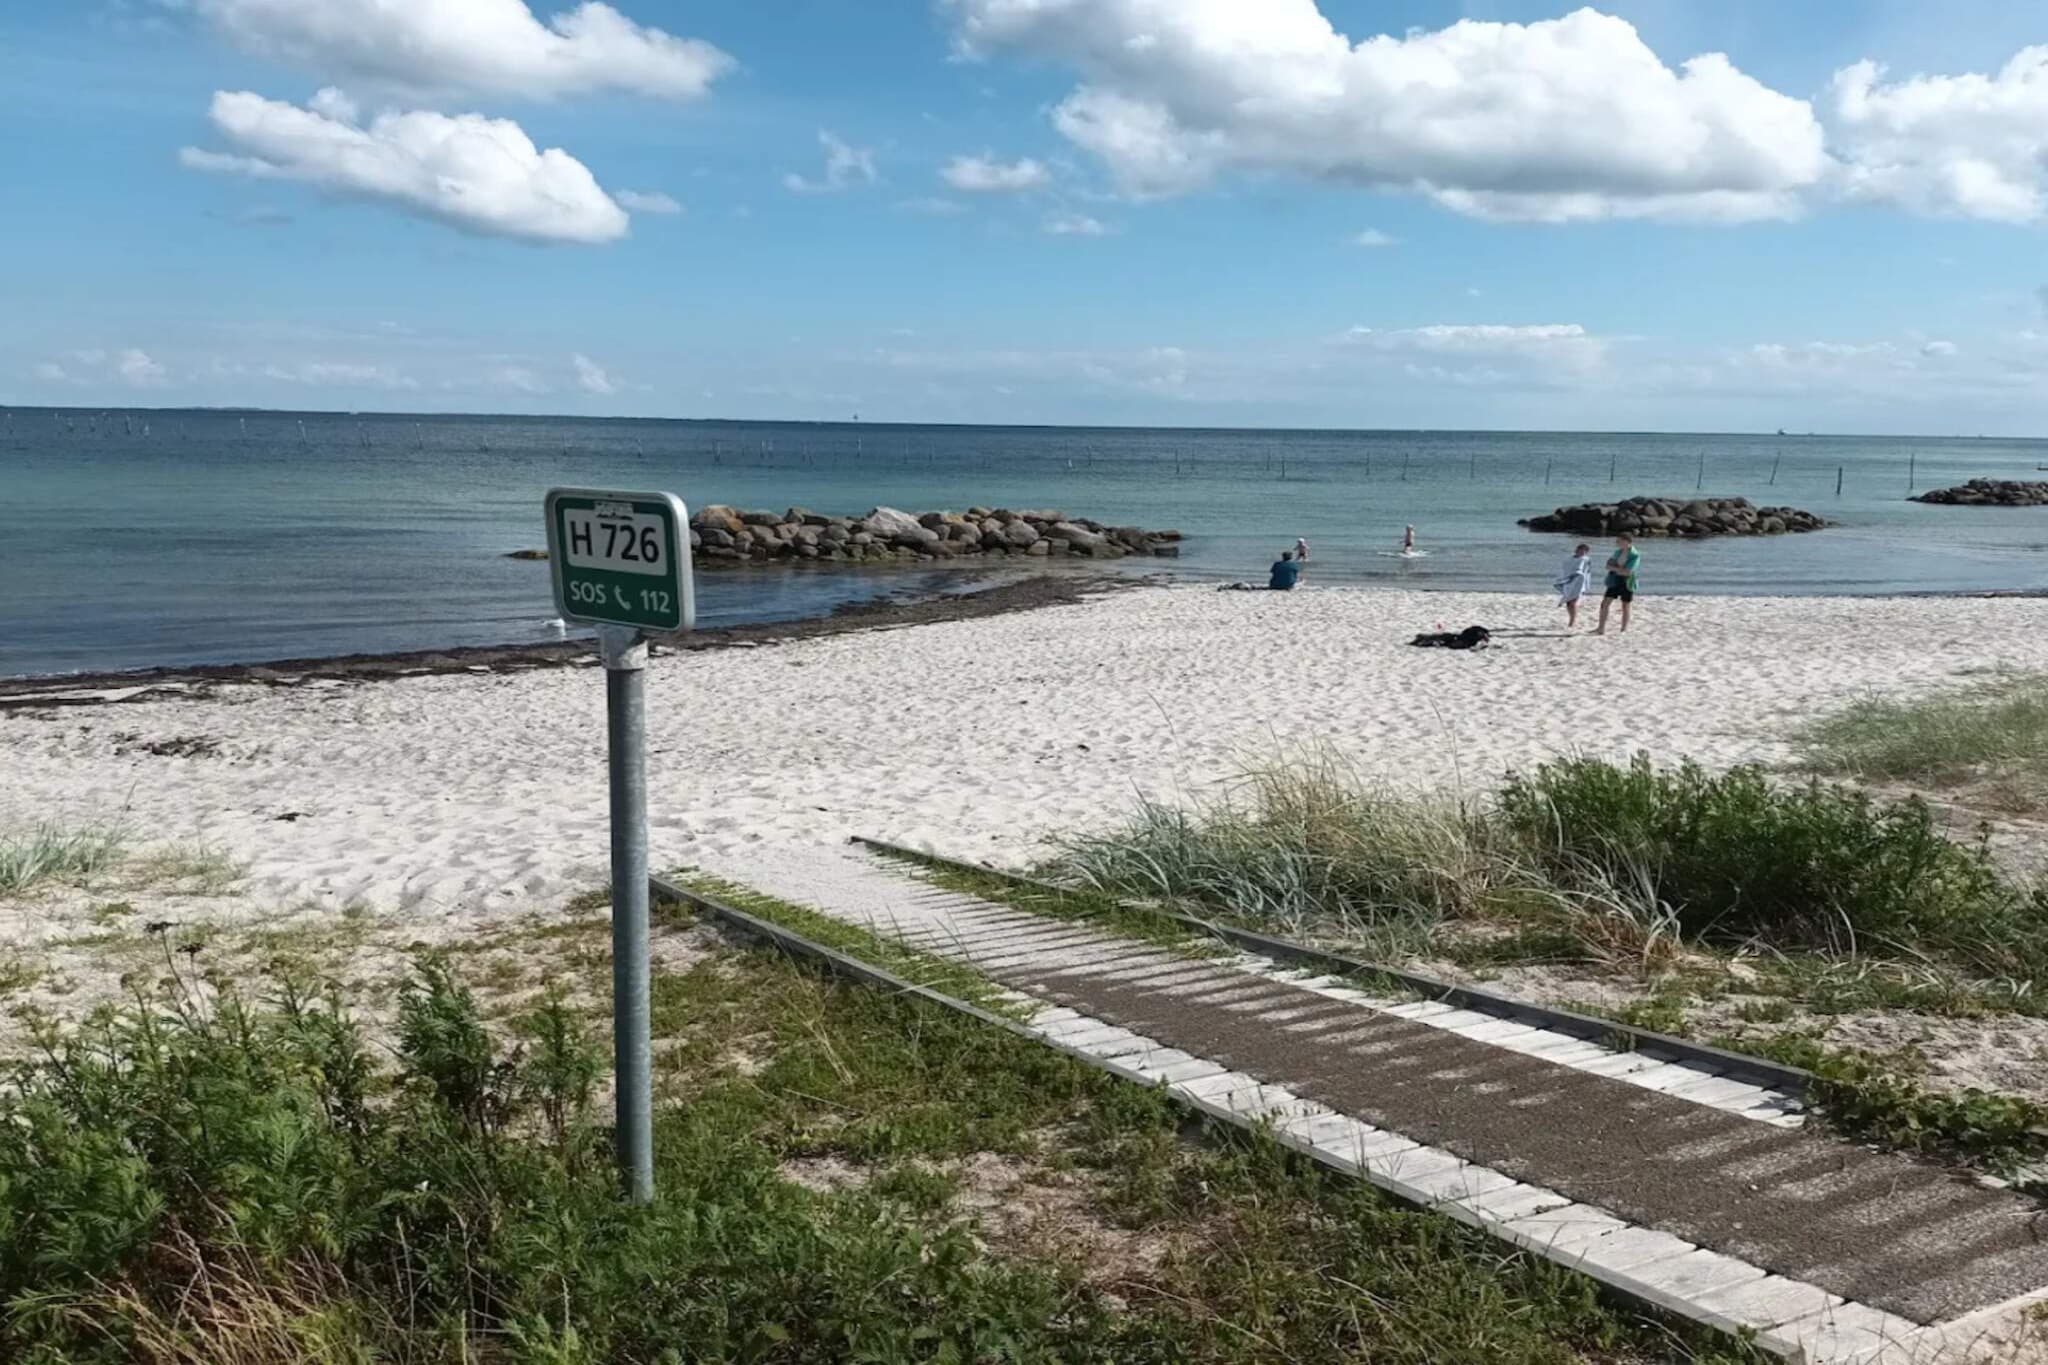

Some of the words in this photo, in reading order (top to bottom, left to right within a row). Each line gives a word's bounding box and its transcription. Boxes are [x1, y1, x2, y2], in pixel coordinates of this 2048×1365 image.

[570, 520, 593, 556] H
[600, 522, 660, 564] 726
[569, 580, 607, 604] SOS
[639, 589, 671, 613] 112
